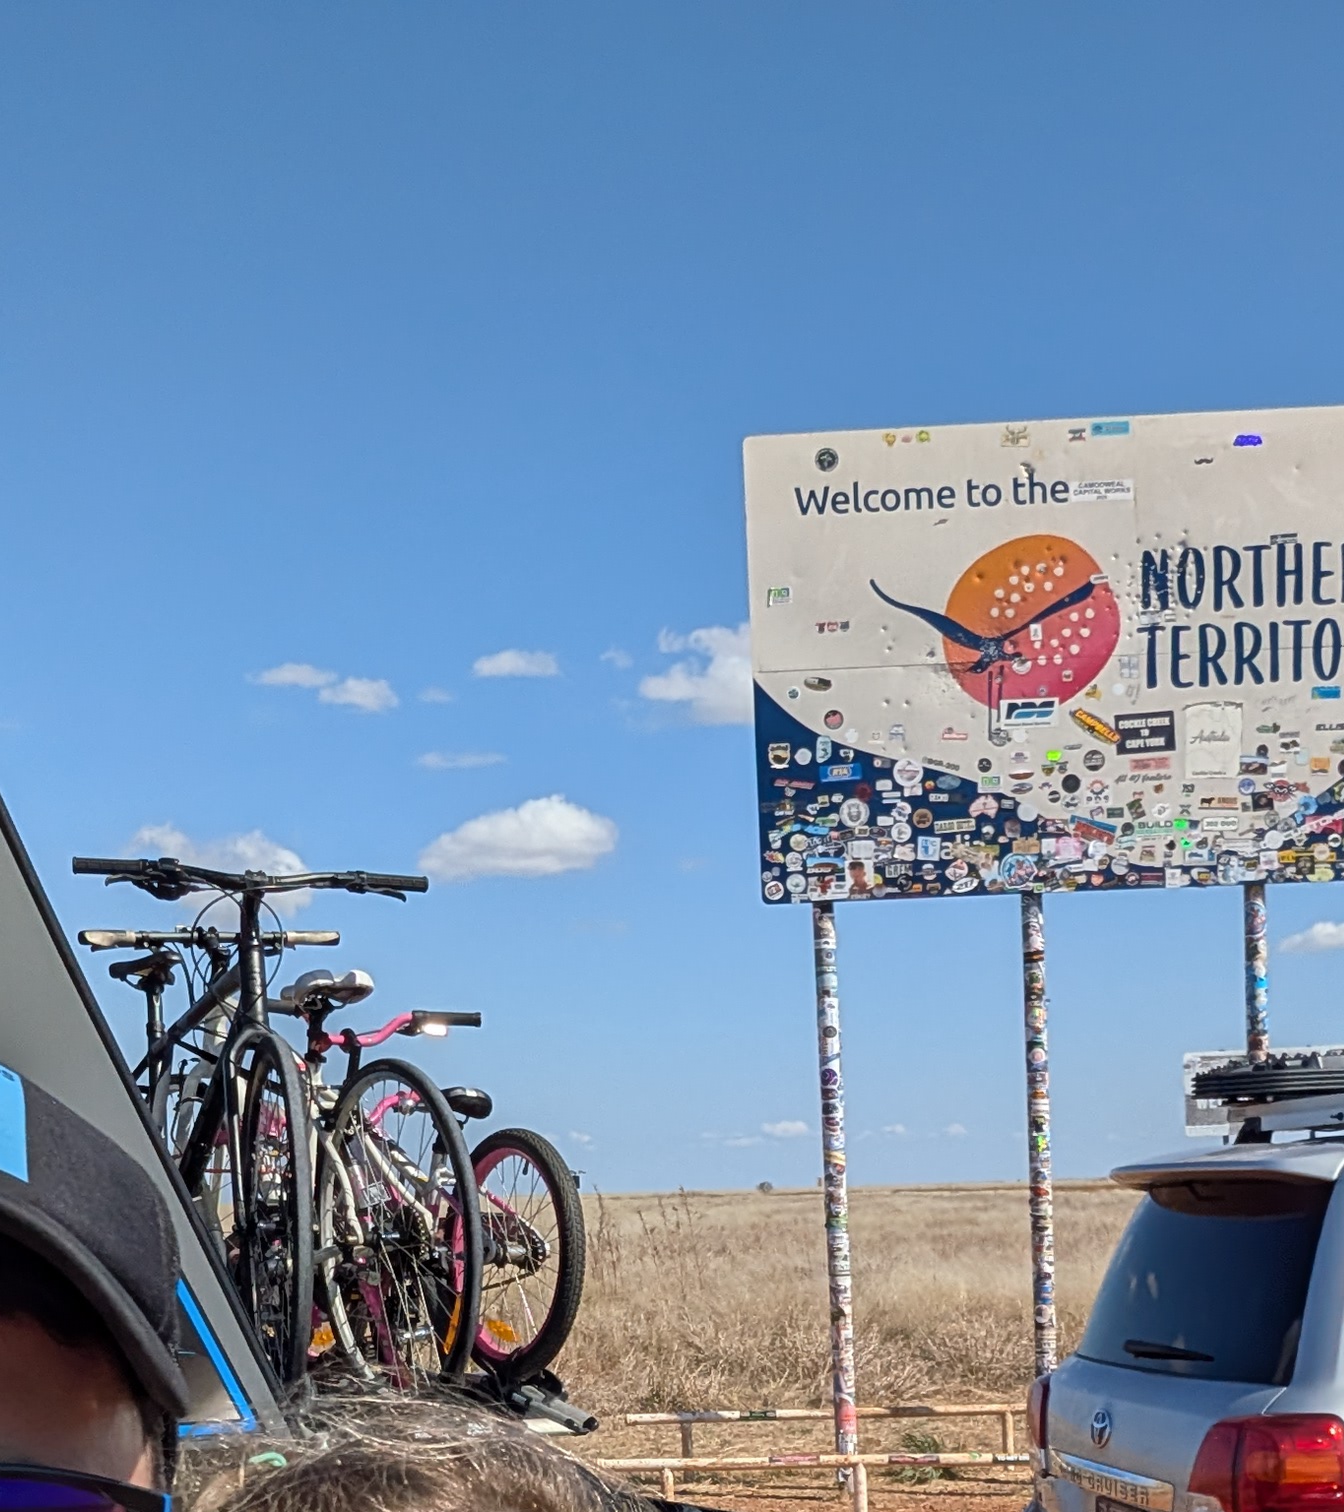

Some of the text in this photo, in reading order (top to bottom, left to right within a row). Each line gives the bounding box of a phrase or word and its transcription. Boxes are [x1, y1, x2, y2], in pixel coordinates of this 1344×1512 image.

[794, 472, 1070, 516] Welcome to the
[1074, 708, 1121, 744] CAMPBELLS
[1137, 820, 1174, 829] BUILD
